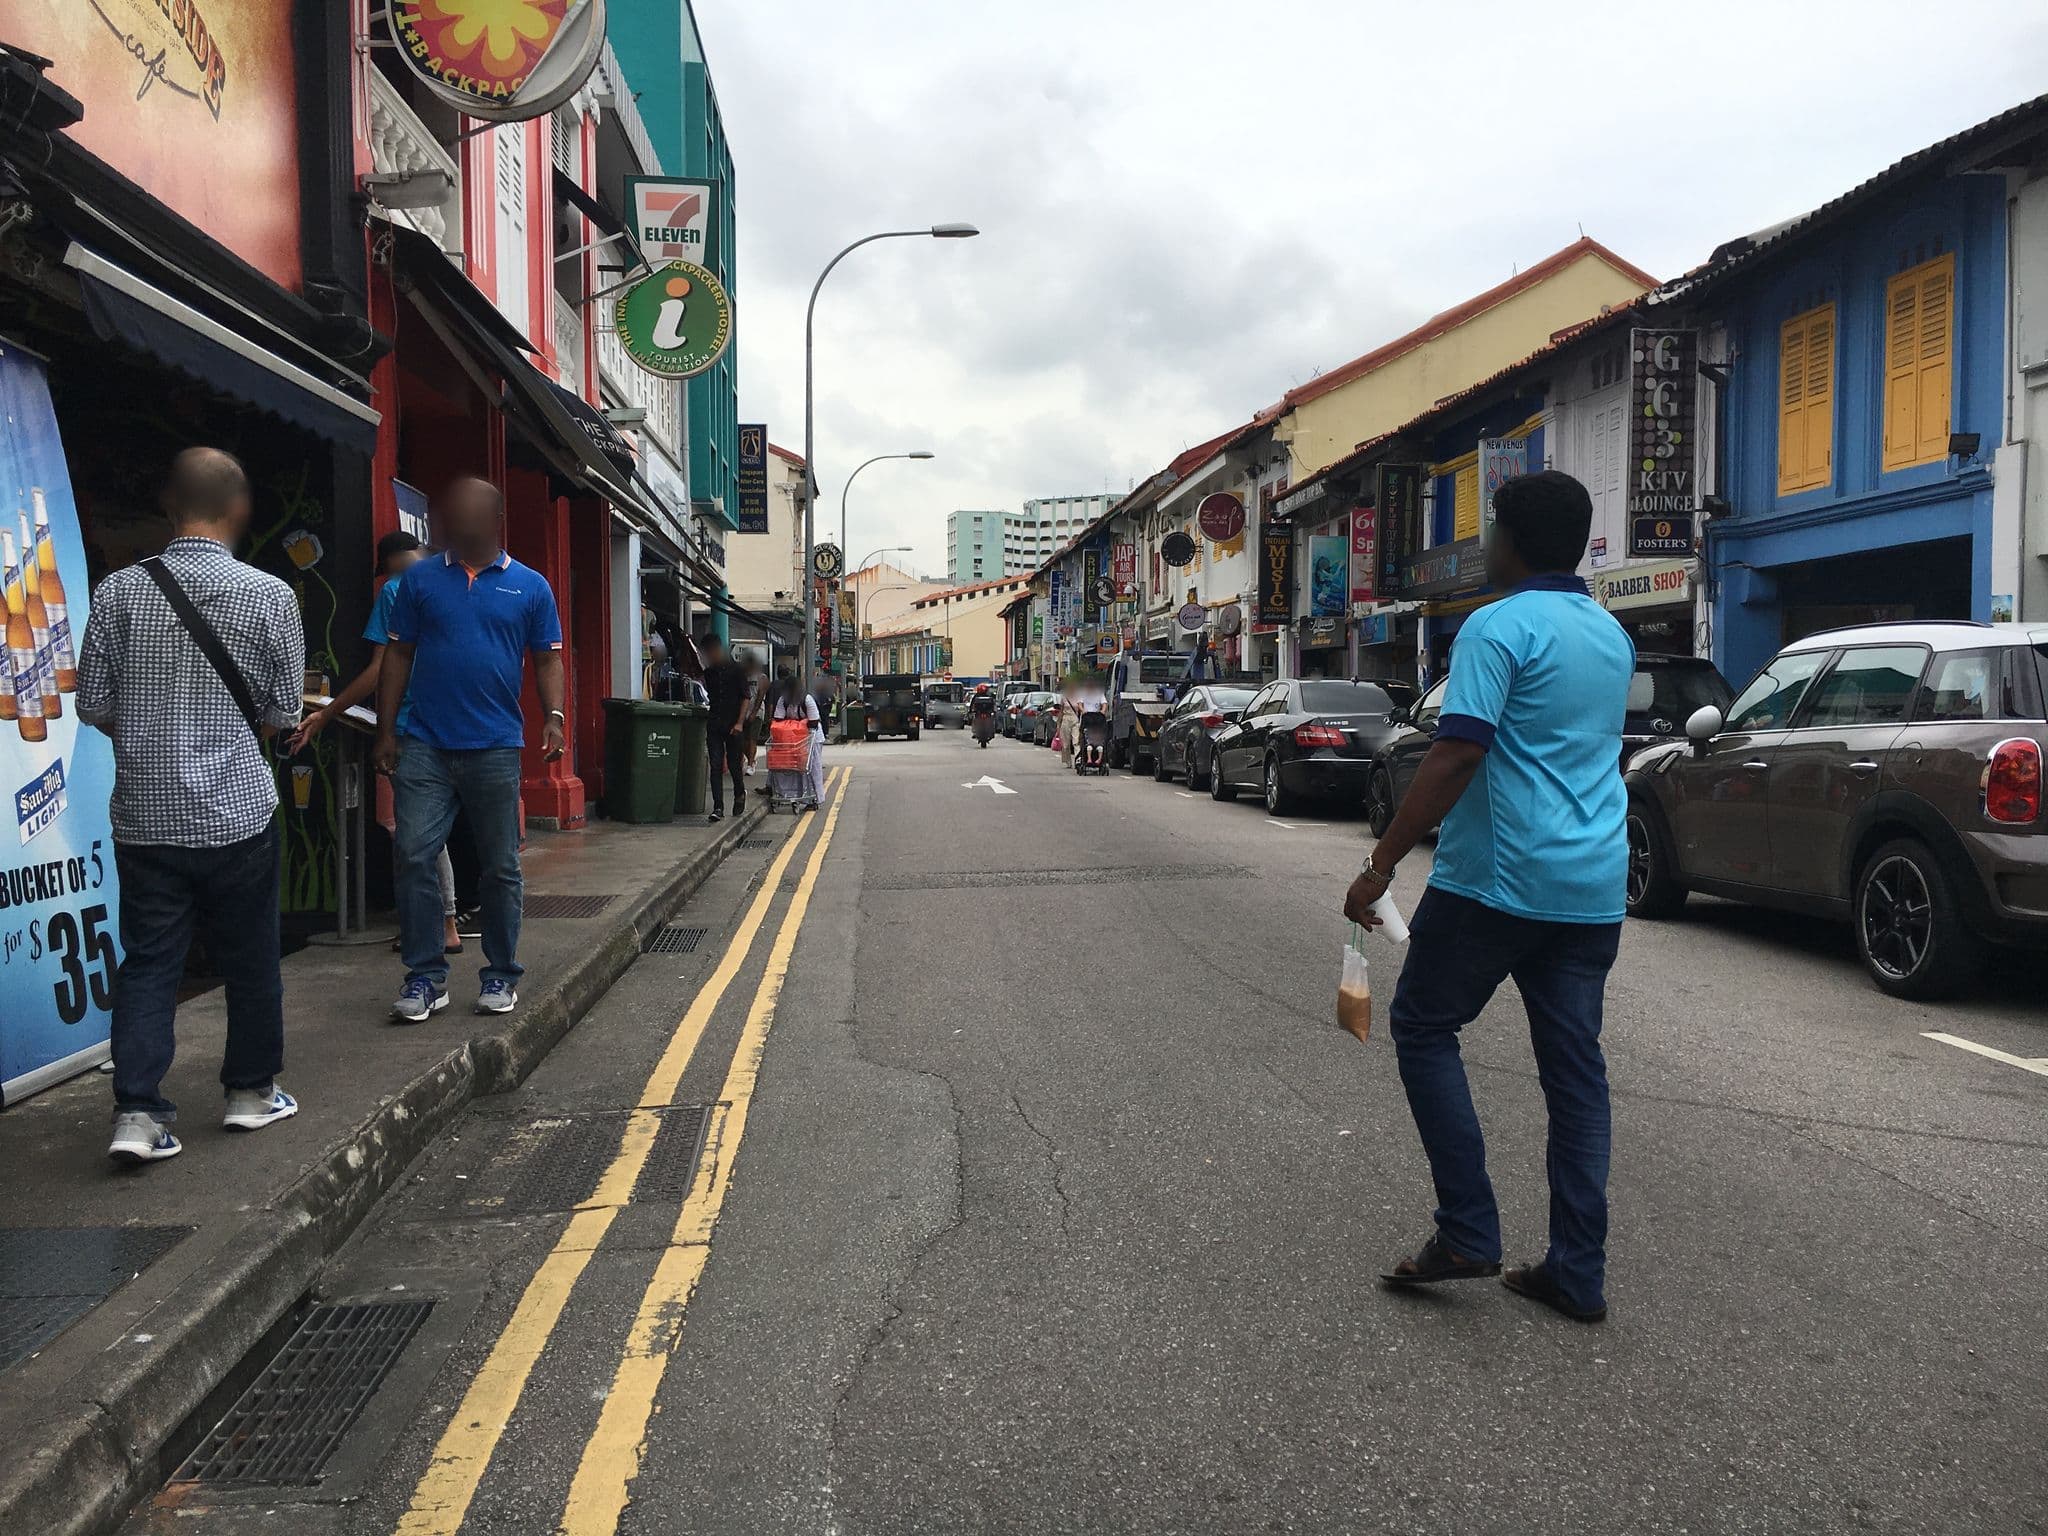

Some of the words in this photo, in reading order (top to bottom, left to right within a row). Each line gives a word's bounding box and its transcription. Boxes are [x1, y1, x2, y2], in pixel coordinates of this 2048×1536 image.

[411, 43, 526, 97] BACKPAC
[619, 324, 635, 348] THE
[709, 309, 728, 351] HOSTEL
[634, 350, 711, 372] INFORMATION
[649, 350, 695, 364] TOURIST
[1486, 439, 1501, 449] NEW
[1640, 471, 1687, 491] KTV
[1632, 495, 1693, 512] LOUNGE
[1264, 537, 1290, 545] INDIAN
[1637, 539, 1687, 549] FOSTER'S
[1115, 545, 1134, 562] JAP
[1119, 562, 1131, 572] AIR
[1268, 545, 1287, 607] MUSIC
[1116, 572, 1134, 583] TOURS
[1607, 576, 1651, 598] BARBER
[1653, 569, 1685, 591] SHOP
[20, 789, 44, 817] San
[0, 859, 65, 910] BUCKET
[67, 856, 87, 893] OF
[91, 841, 104, 889] 5
[4, 929, 22, 965] for
